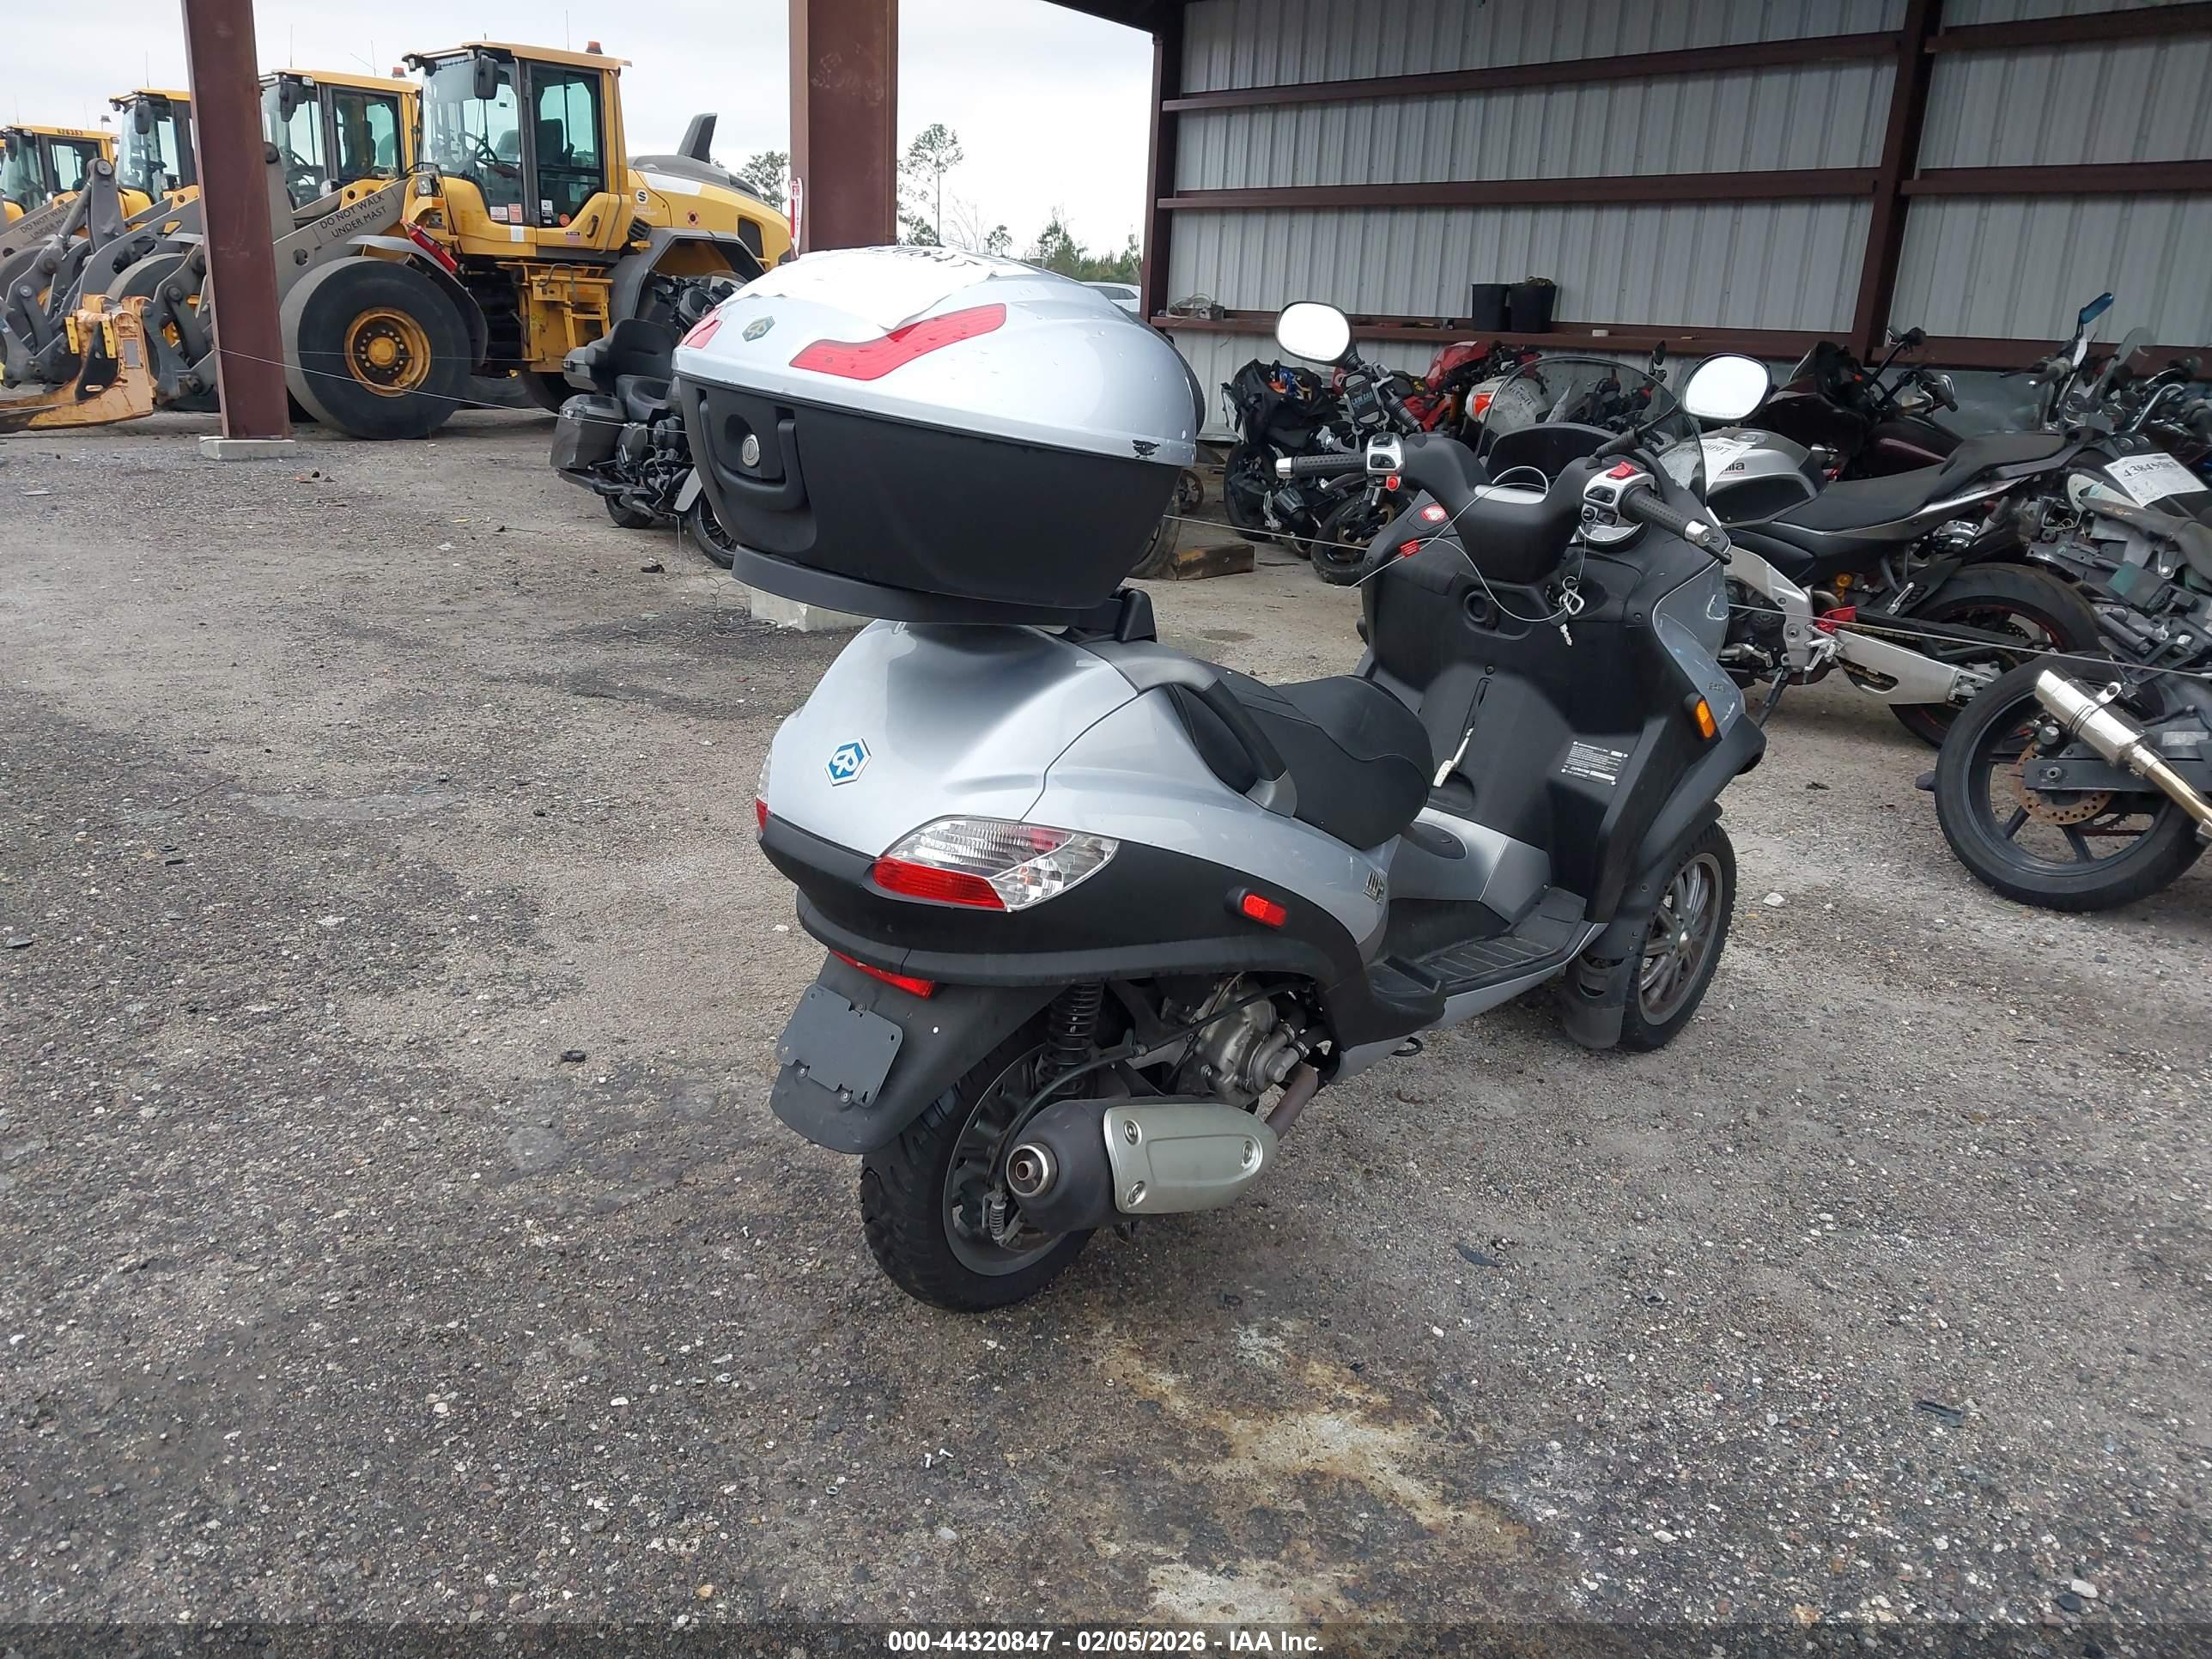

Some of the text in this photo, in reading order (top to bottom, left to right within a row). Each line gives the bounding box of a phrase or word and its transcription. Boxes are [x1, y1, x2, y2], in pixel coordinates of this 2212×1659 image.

[319, 193, 385, 229] DO NOT WALK
[331, 205, 386, 238] UNDER MAST
[20, 223, 33, 233] DO
